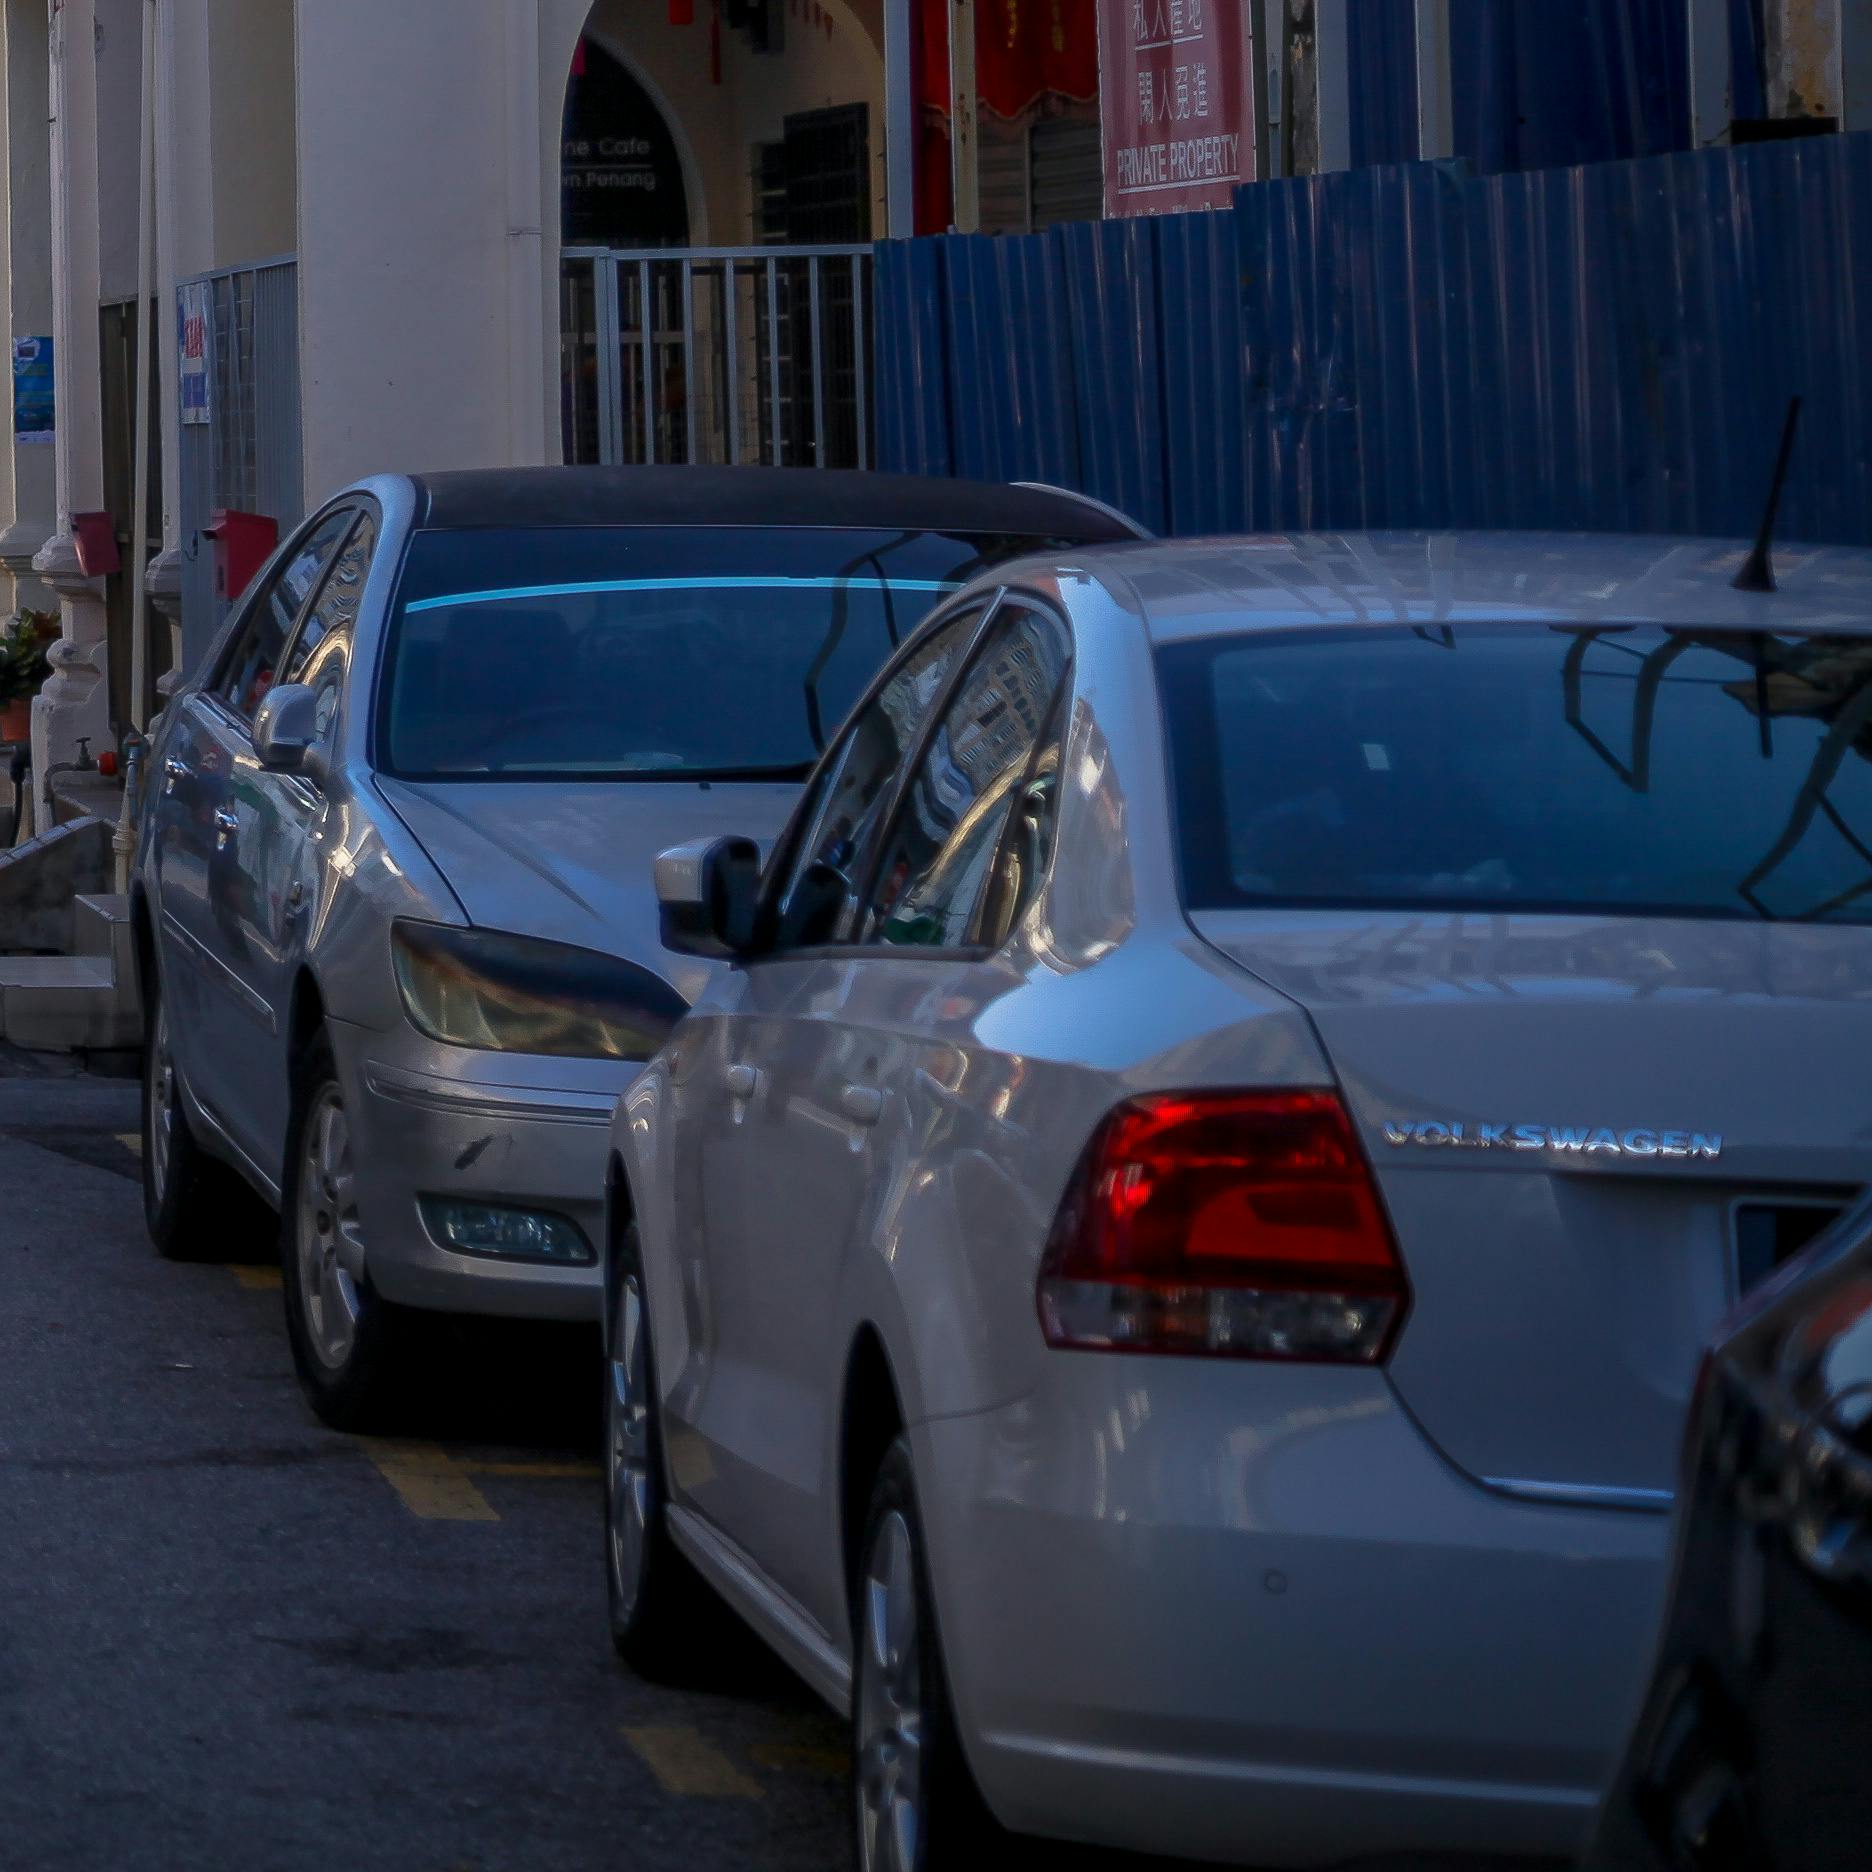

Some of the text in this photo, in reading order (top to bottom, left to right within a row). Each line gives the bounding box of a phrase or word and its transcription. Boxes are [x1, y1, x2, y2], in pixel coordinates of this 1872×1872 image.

[1117, 133, 1240, 187] PRIVATE PROPERTY
[1381, 1119, 1724, 1159] VOLKSWAGEN
